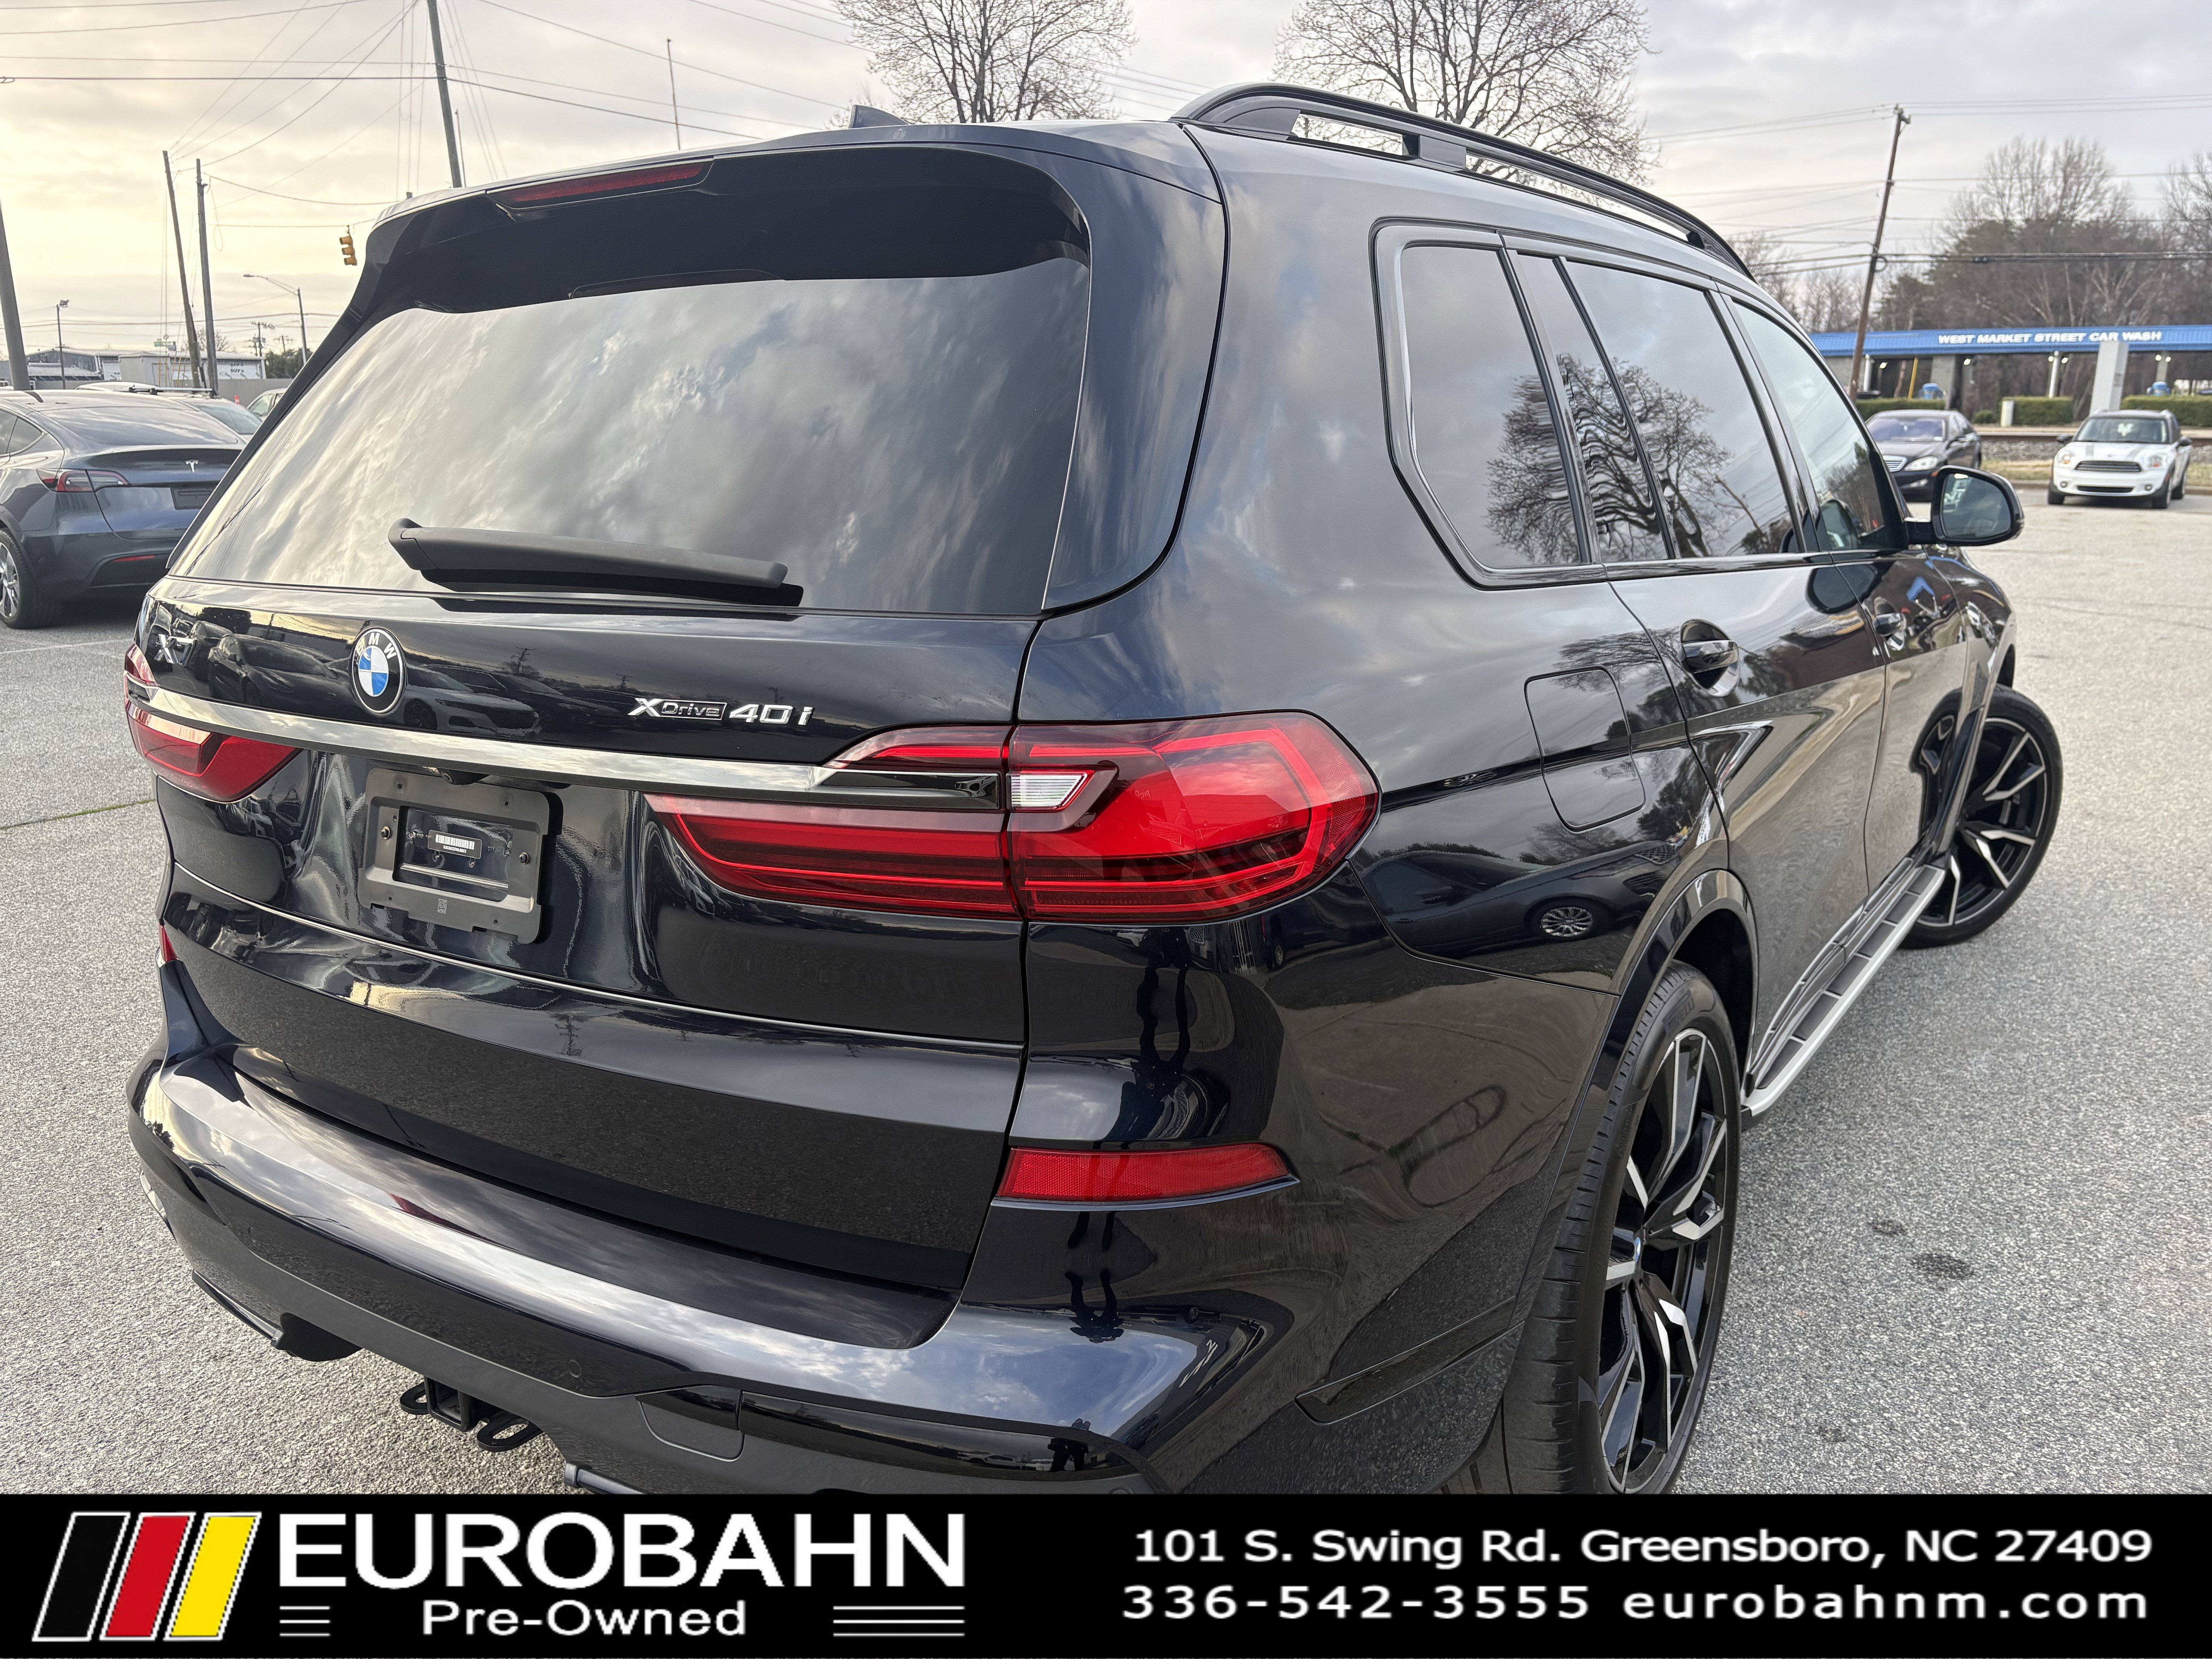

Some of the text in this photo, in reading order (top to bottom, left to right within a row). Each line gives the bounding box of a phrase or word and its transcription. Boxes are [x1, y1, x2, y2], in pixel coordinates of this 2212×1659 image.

[1939, 331, 2162, 343] WEST MARKET STREET CAR WASH
[356, 632, 397, 659] BMW
